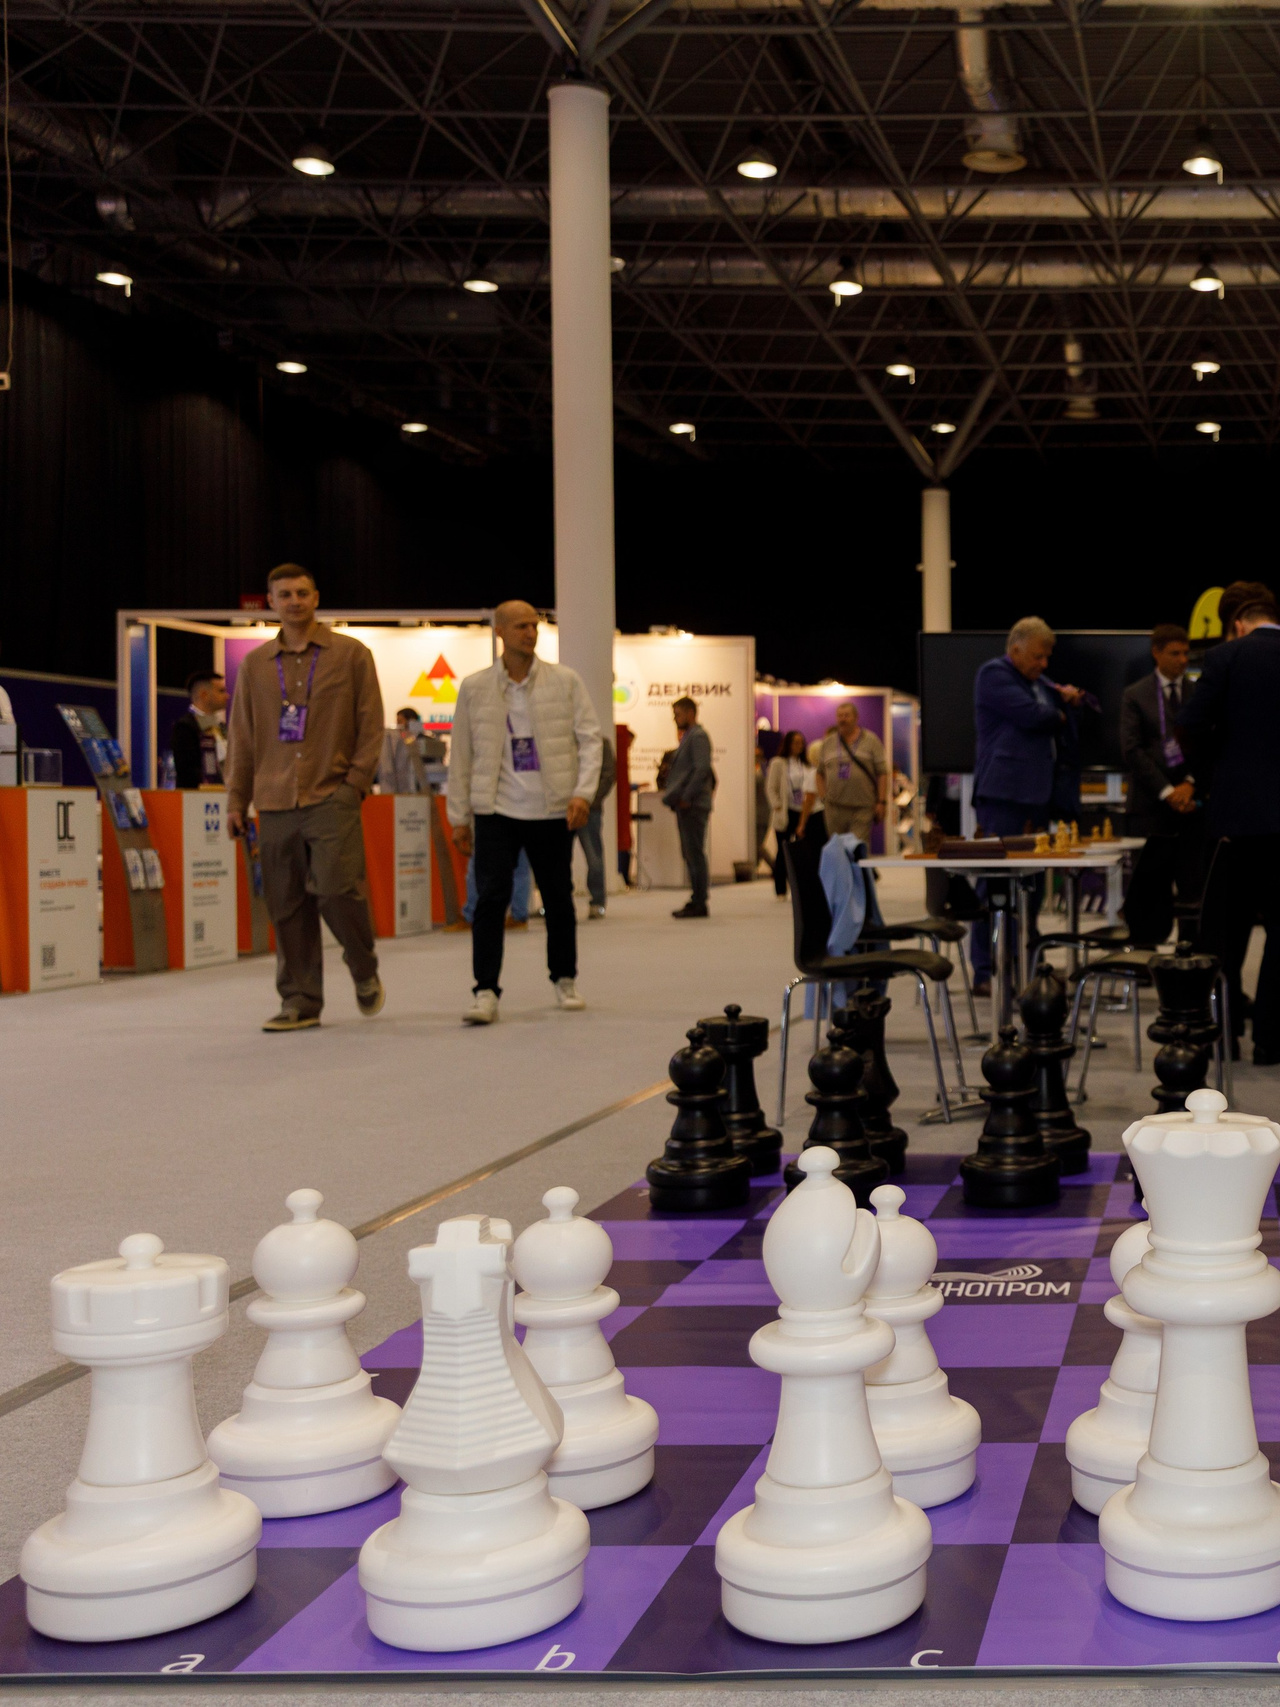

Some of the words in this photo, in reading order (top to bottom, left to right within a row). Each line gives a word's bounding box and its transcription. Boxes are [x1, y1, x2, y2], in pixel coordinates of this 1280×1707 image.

[648, 683, 732, 697] ДЕНВИК
[161, 1653, 205, 1673] a
[534, 1644, 576, 1671] b
[910, 1649, 944, 1668] c
